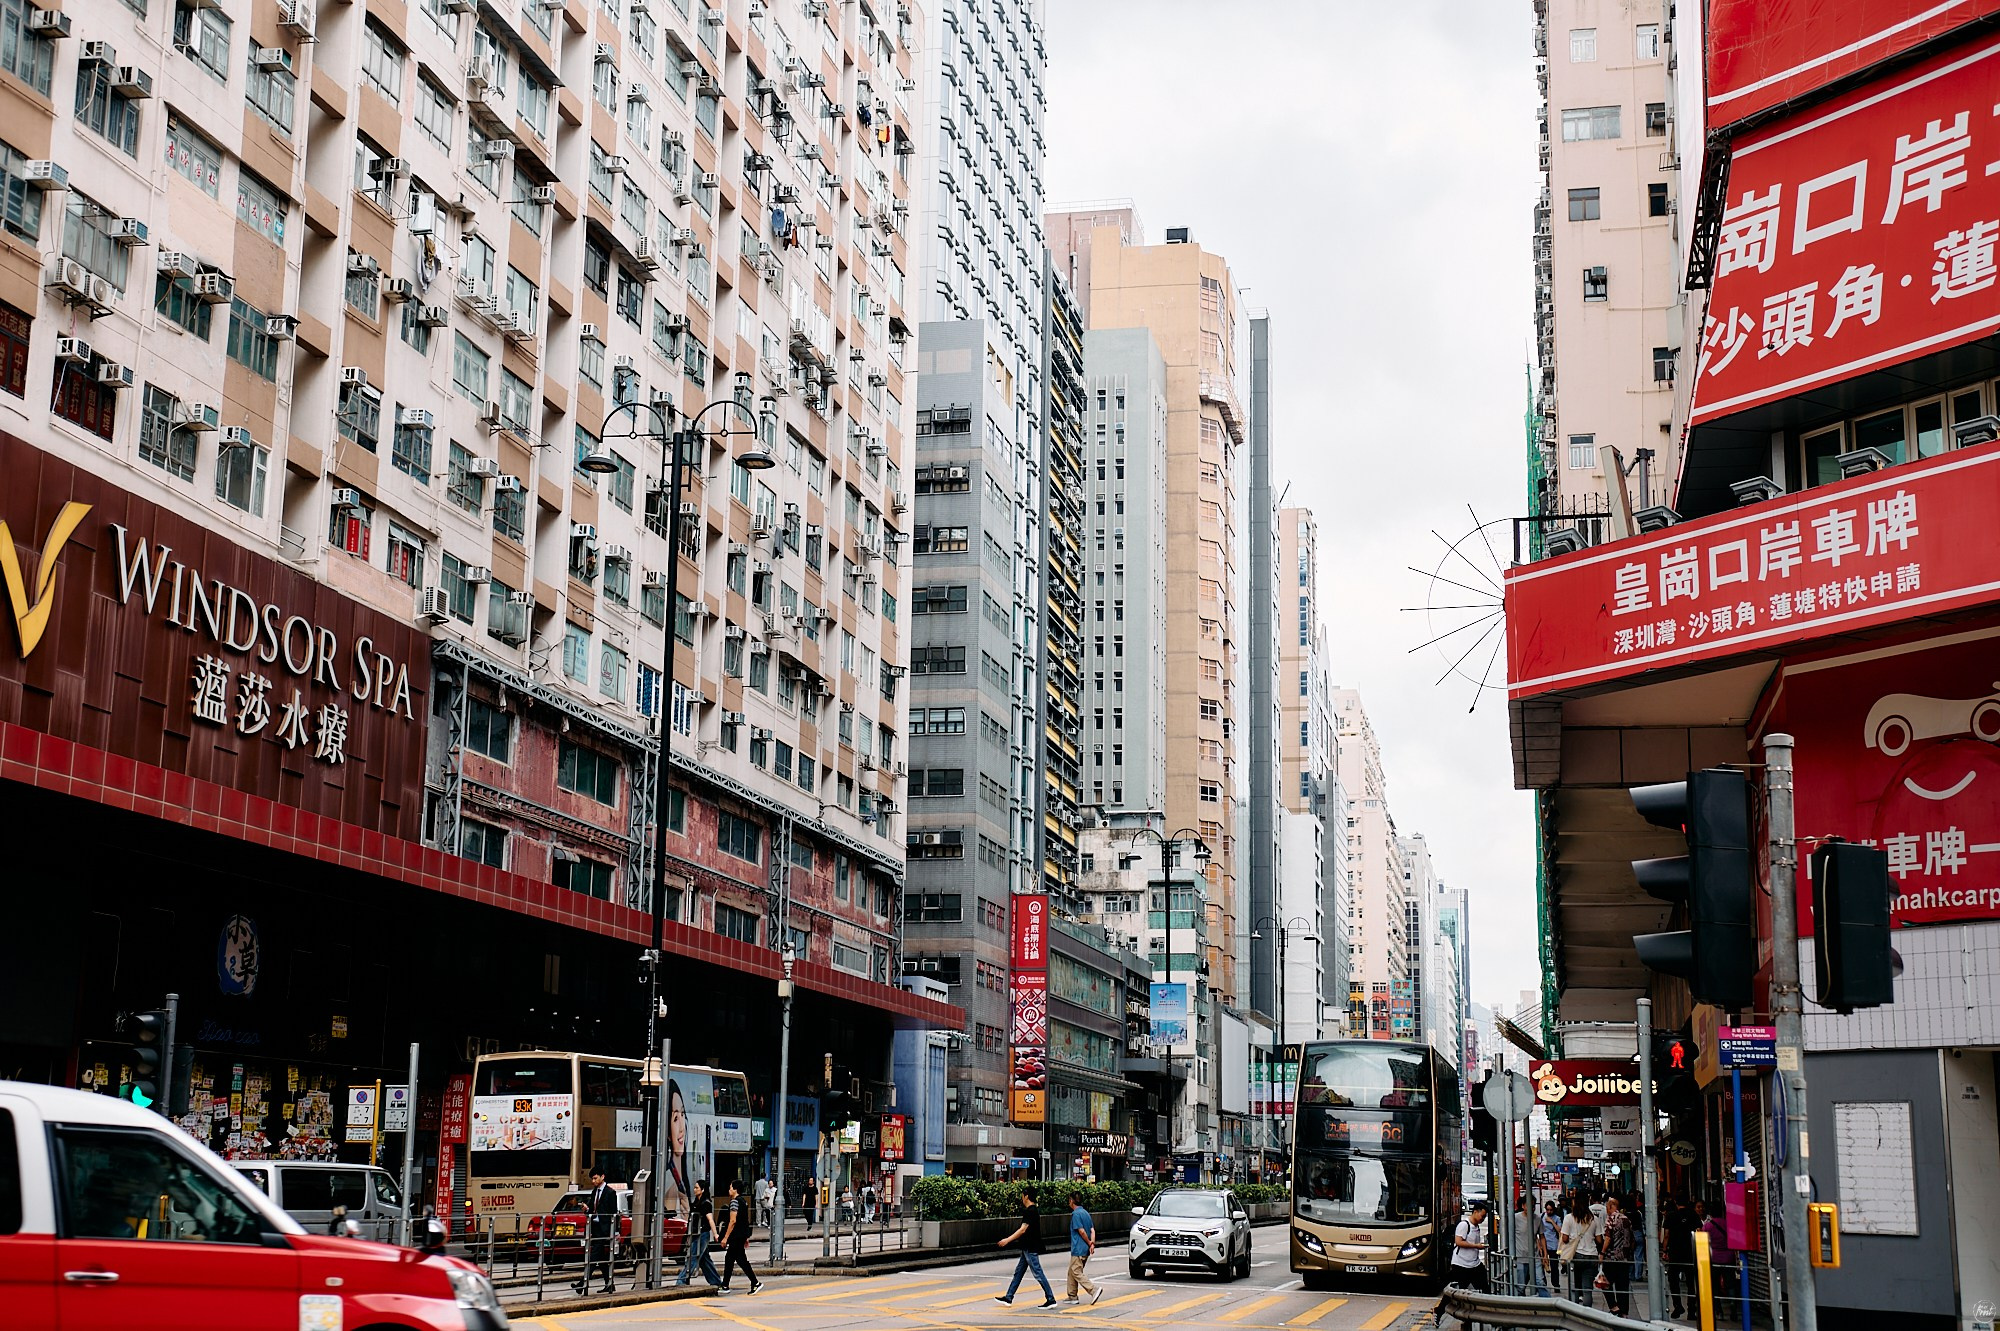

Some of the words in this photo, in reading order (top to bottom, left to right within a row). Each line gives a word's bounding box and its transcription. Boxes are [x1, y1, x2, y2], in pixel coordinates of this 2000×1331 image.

[1718, 104, 2000, 277] 崗口岸
[1612, 489, 1920, 617] 皇崗口岸車牌
[110, 522, 342, 691] WINDSOR
[352, 635, 415, 721] SPA
[515, 1099, 533, 1113] 93K
[1081, 1134, 1104, 1144] Ponti
[491, 1195, 515, 1206] KMB
